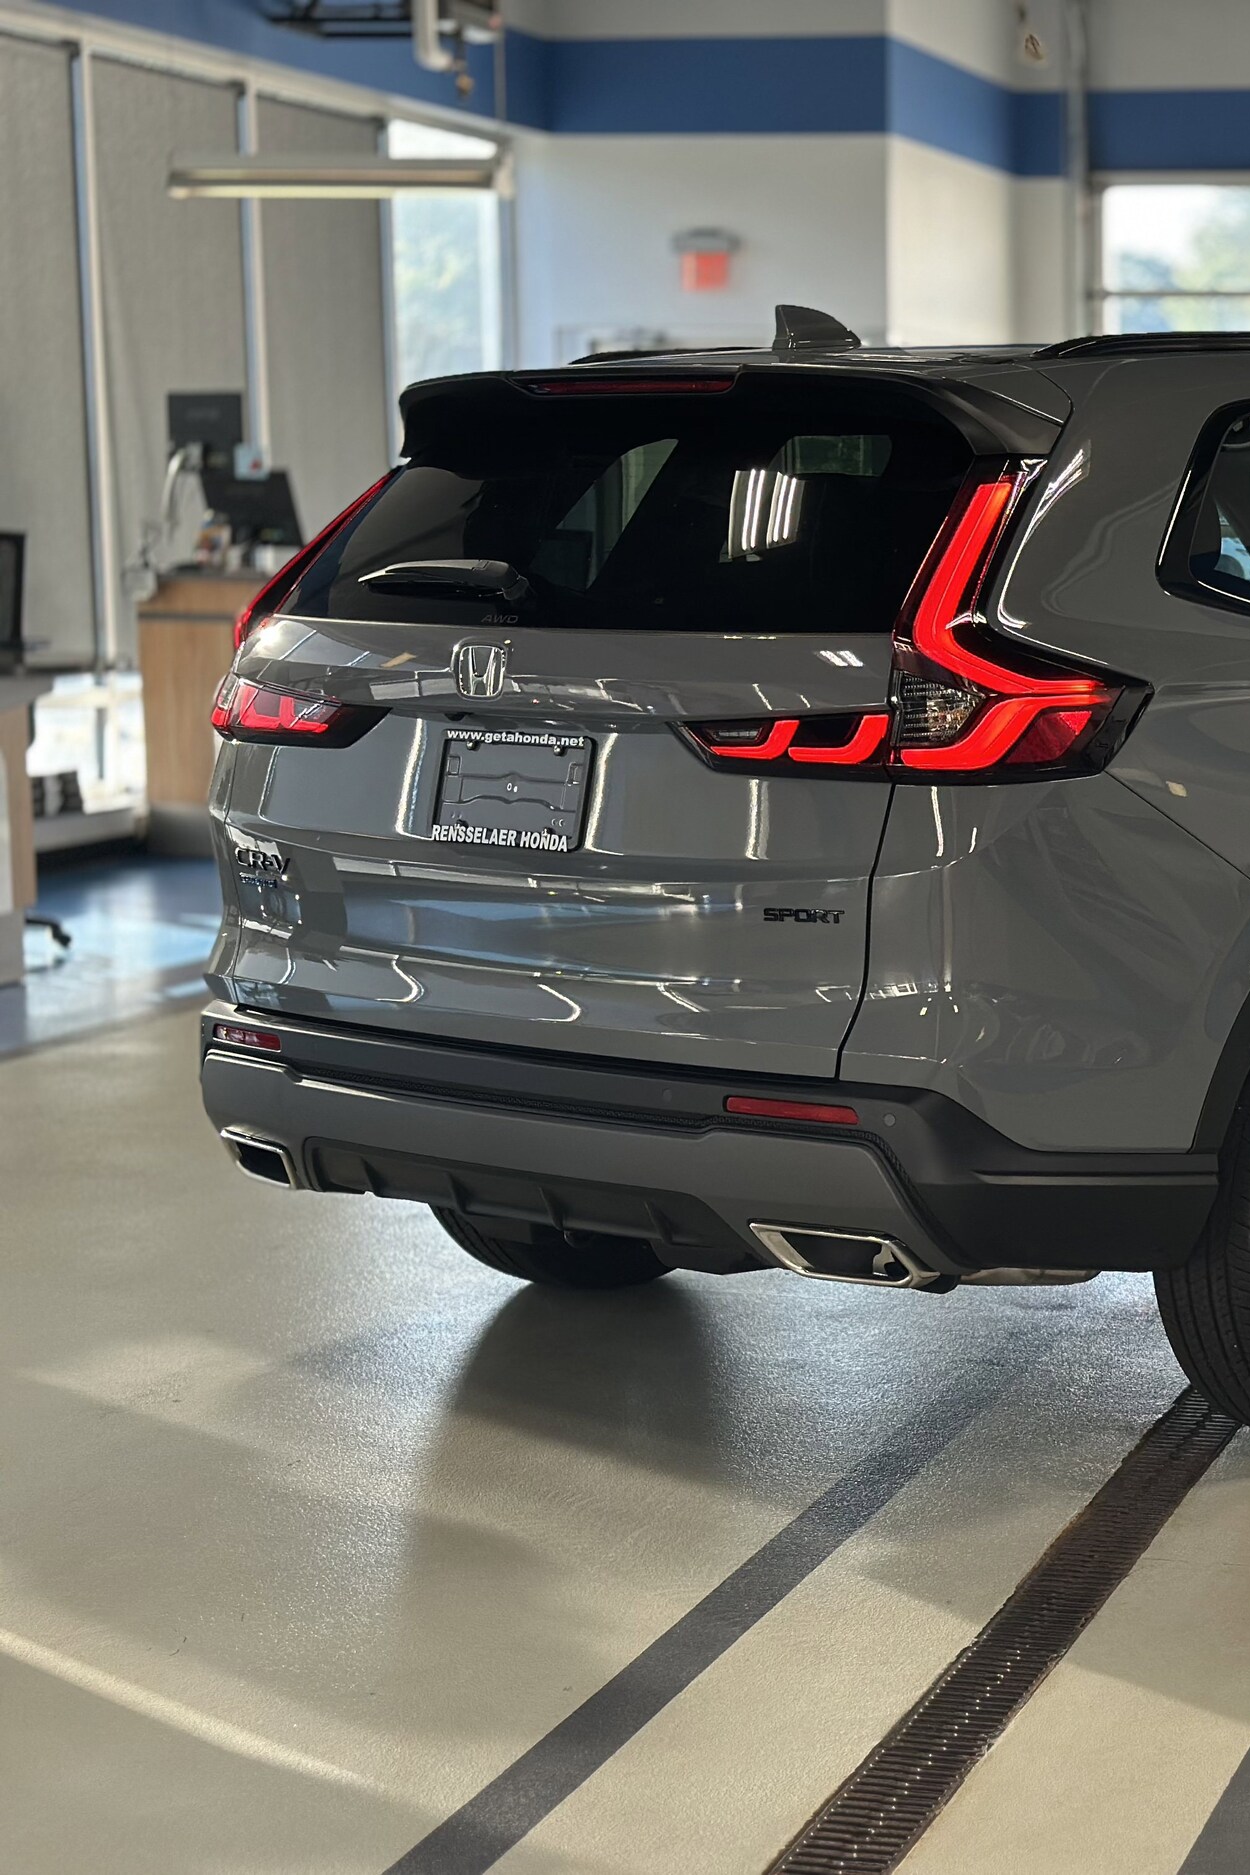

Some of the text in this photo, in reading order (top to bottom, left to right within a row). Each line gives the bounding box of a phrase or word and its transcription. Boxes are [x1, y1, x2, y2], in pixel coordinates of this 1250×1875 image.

[480, 614, 519, 624] AWD
[446, 729, 586, 747] www.getahonda.net
[432, 823, 569, 853] RENSSELAER HONDA
[234, 846, 291, 875] CR-V
[763, 907, 845, 924] SPORT
